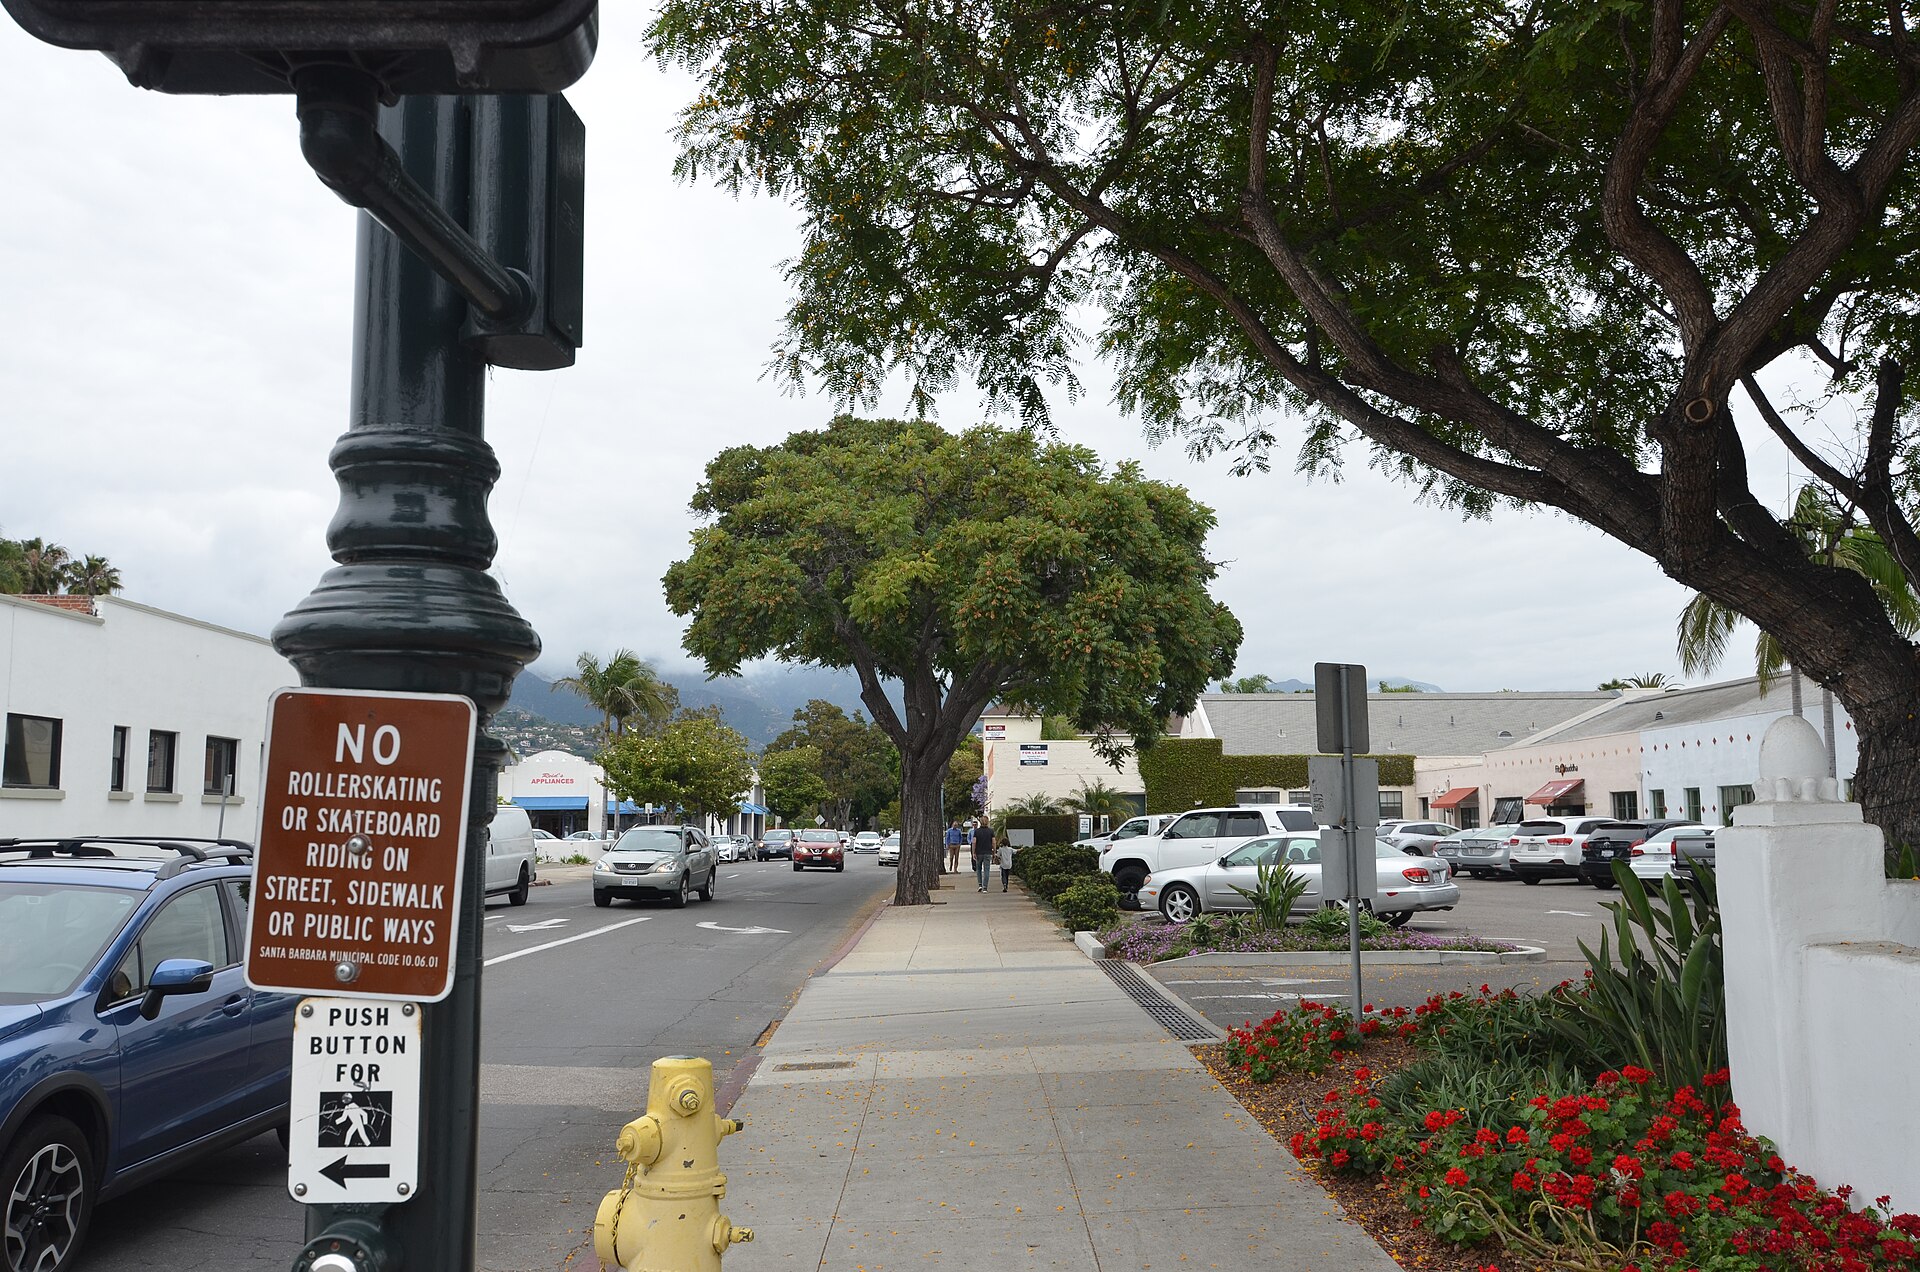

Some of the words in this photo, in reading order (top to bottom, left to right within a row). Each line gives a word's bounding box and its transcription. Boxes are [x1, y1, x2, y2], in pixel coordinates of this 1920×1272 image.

[335, 723, 401, 766] NO
[288, 771, 442, 803] ROLLERSKATING
[281, 805, 307, 831] OR
[316, 808, 440, 838] SKATEBOARD
[306, 843, 373, 870] RIDING
[383, 847, 409, 872] ON
[265, 876, 336, 905] STREET,
[347, 880, 445, 909] SIDEWALK
[268, 911, 294, 937] OR
[304, 914, 373, 941] PUBLIC
[383, 919, 435, 945] WAYS
[260, 946, 286, 959] SANTA
[288, 948, 327, 961] BARBARA
[330, 951, 375, 965] MUNICIPAL
[377, 954, 400, 966] CODE
[402, 954, 438, 968] 10.06.01
[329, 1008, 389, 1026] PUSH
[310, 1036, 406, 1055] BUTTON
[336, 1064, 381, 1083] FOR
